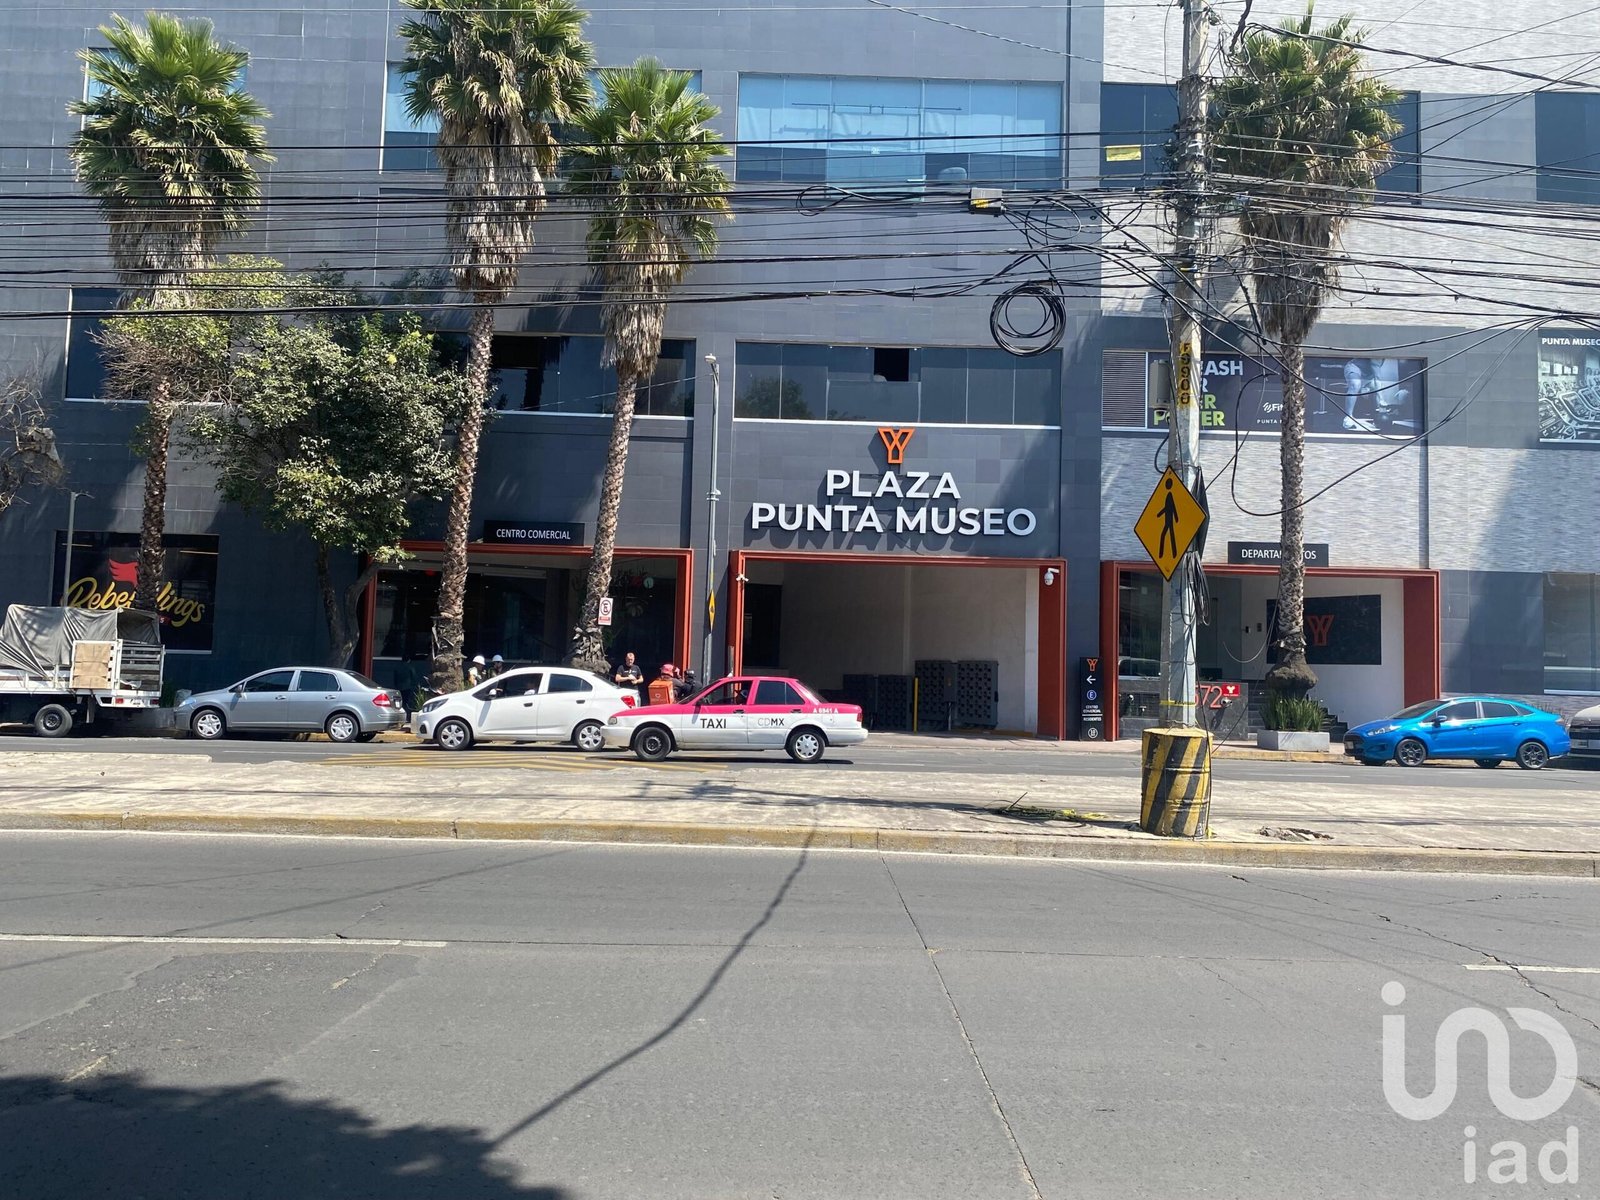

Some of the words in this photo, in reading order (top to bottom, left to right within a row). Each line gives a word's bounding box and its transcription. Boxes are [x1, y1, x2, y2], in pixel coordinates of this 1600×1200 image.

[1542, 337, 1570, 345] PUNTA
[826, 469, 961, 499] PLAZA
[751, 502, 884, 533] PUNTA
[895, 506, 1037, 536] MUSEO
[496, 528, 526, 538] CENTRO
[528, 529, 571, 540] COMERCIAL
[700, 718, 727, 729] TAXI
[757, 718, 785, 727] CDMX
